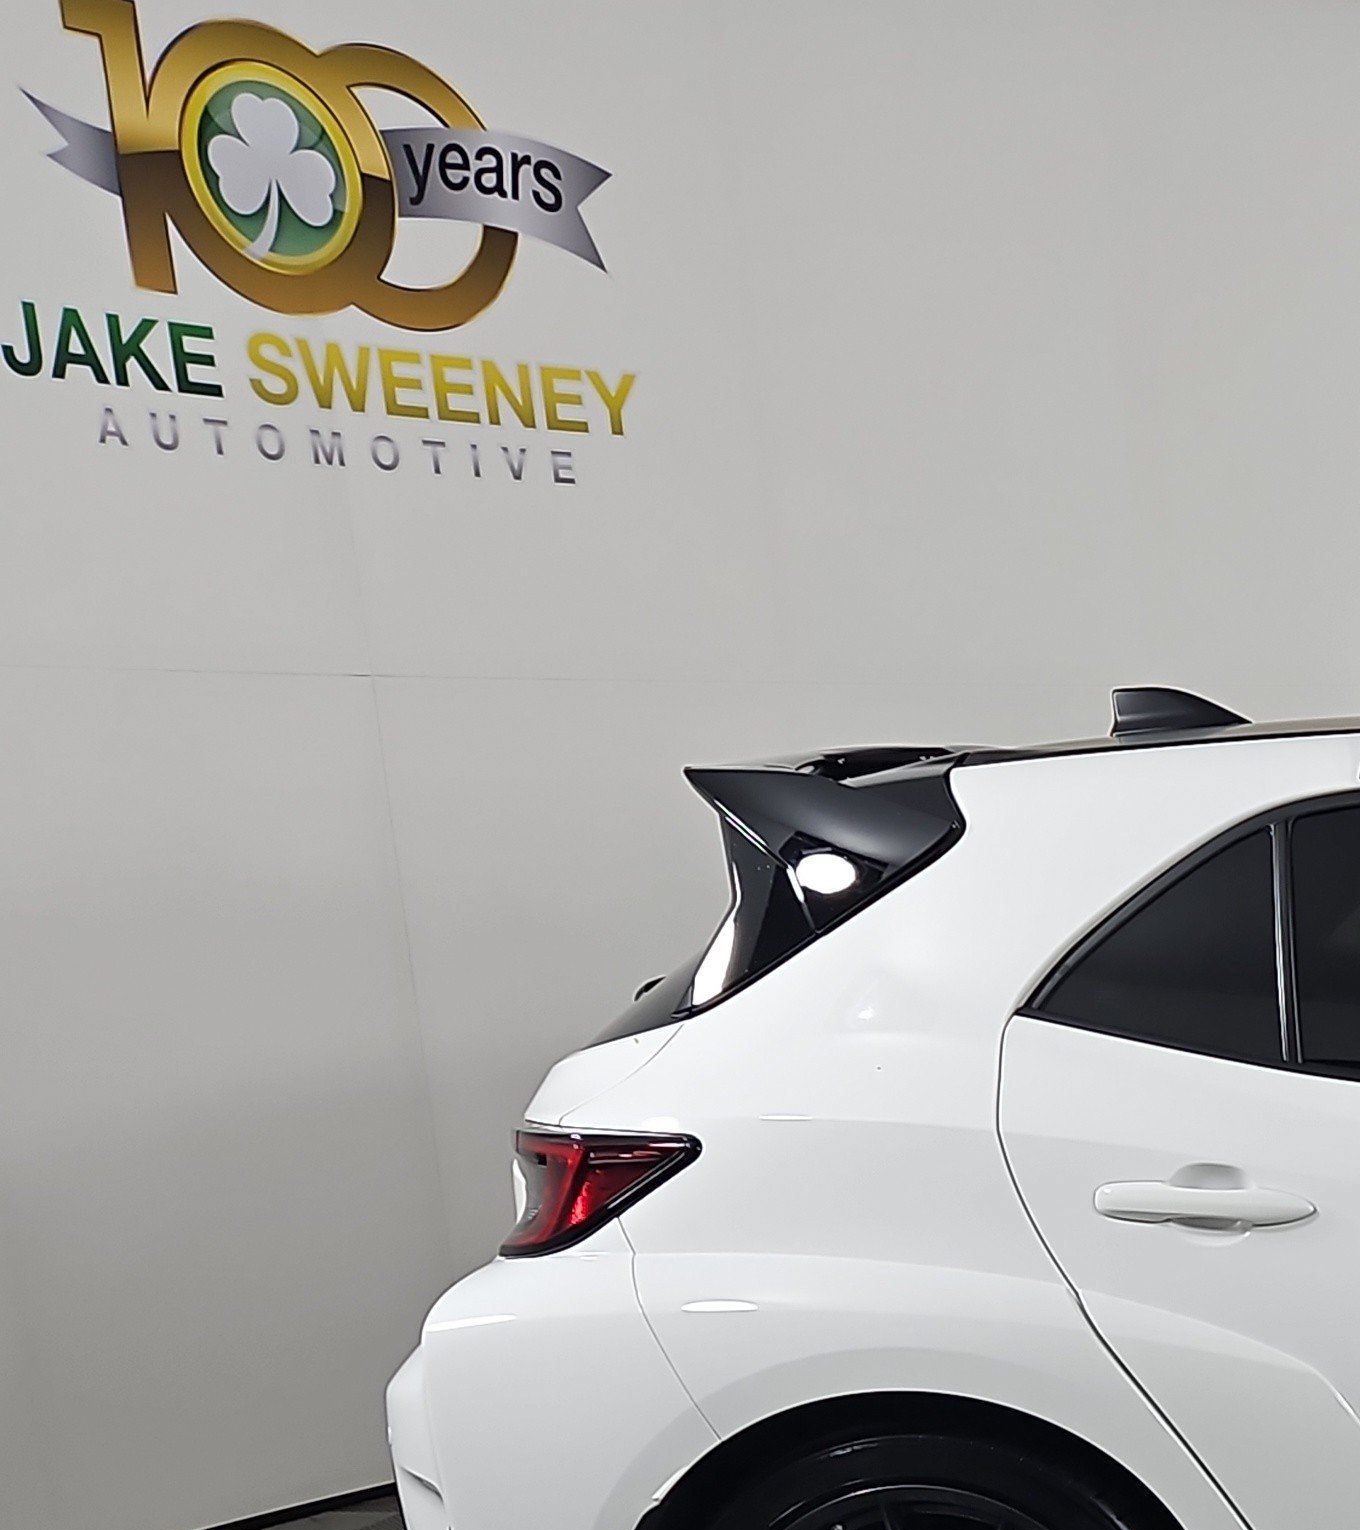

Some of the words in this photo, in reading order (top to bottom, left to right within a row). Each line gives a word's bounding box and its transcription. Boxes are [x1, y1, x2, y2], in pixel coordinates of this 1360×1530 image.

[402, 140, 564, 213] years
[1, 300, 225, 399] JAKE
[246, 331, 638, 437] SWEENEY
[98, 406, 577, 486] AUTOMOTIVE
